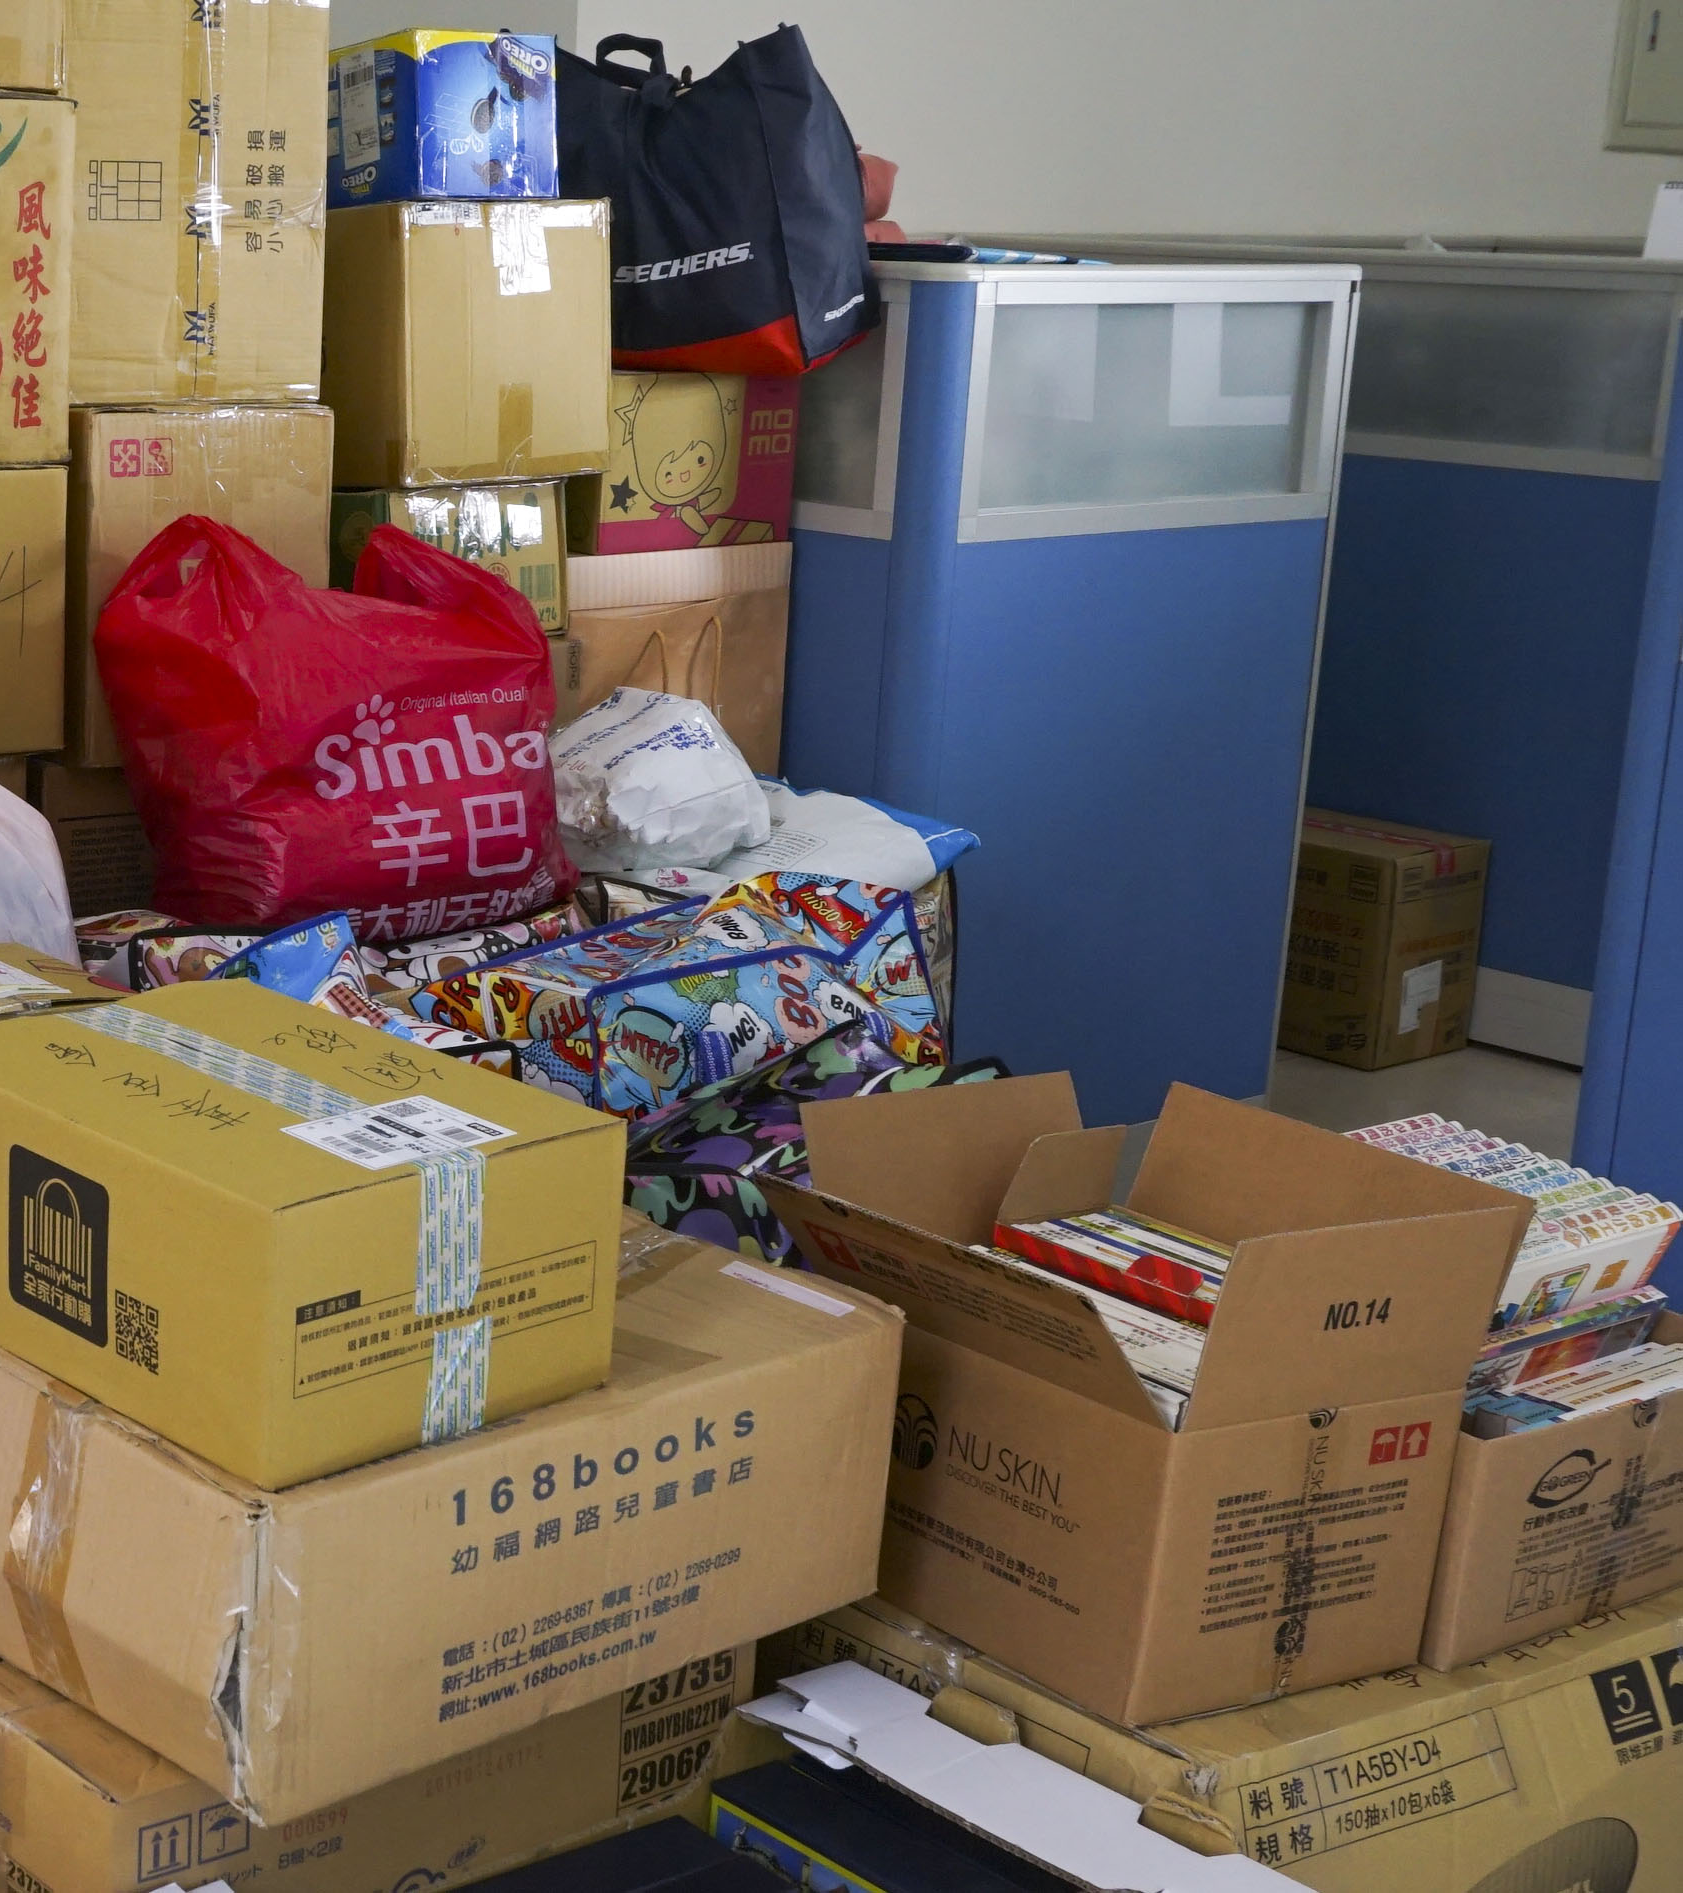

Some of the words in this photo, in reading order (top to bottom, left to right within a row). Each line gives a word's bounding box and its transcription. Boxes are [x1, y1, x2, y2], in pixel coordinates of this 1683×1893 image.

[501, 36, 551, 73] OREO
[244, 129, 265, 253] 容易破損
[265, 128, 287, 253] 小心搬運
[341, 166, 378, 187] OREO
[613, 241, 754, 284] SECHERS
[400, 695, 447, 713] Original
[449, 690, 489, 708] Italian
[315, 714, 547, 800] Simba
[372, 790, 534, 887] 辛巴
[23, 1271, 93, 1328] 全家行動購
[28, 1253, 88, 1293] FamilyMart
[1323, 1297, 1391, 1333] NO.14
[451, 1409, 756, 1526] 168books
[945, 1463, 998, 1496] DISCOVER
[999, 1488, 1020, 1510] THE
[1021, 1498, 1049, 1521] BEST
[1049, 1509, 1075, 1534] YOU
[948, 1425, 992, 1472] NU
[995, 1447, 1061, 1506] SKIN
[450, 1456, 754, 1575] 幼福網路兒童書店
[441, 1584, 701, 1695] 新北市土城區民族街11號3樓
[1613, 1675, 1636, 1716] 5
[1248, 1777, 1308, 1820] 料號
[1322, 1736, 1442, 1796] T1A5BY-D4
[1255, 1824, 1316, 1865] 規格
[1335, 1779, 1457, 1836] 150抽x10包x6袋
